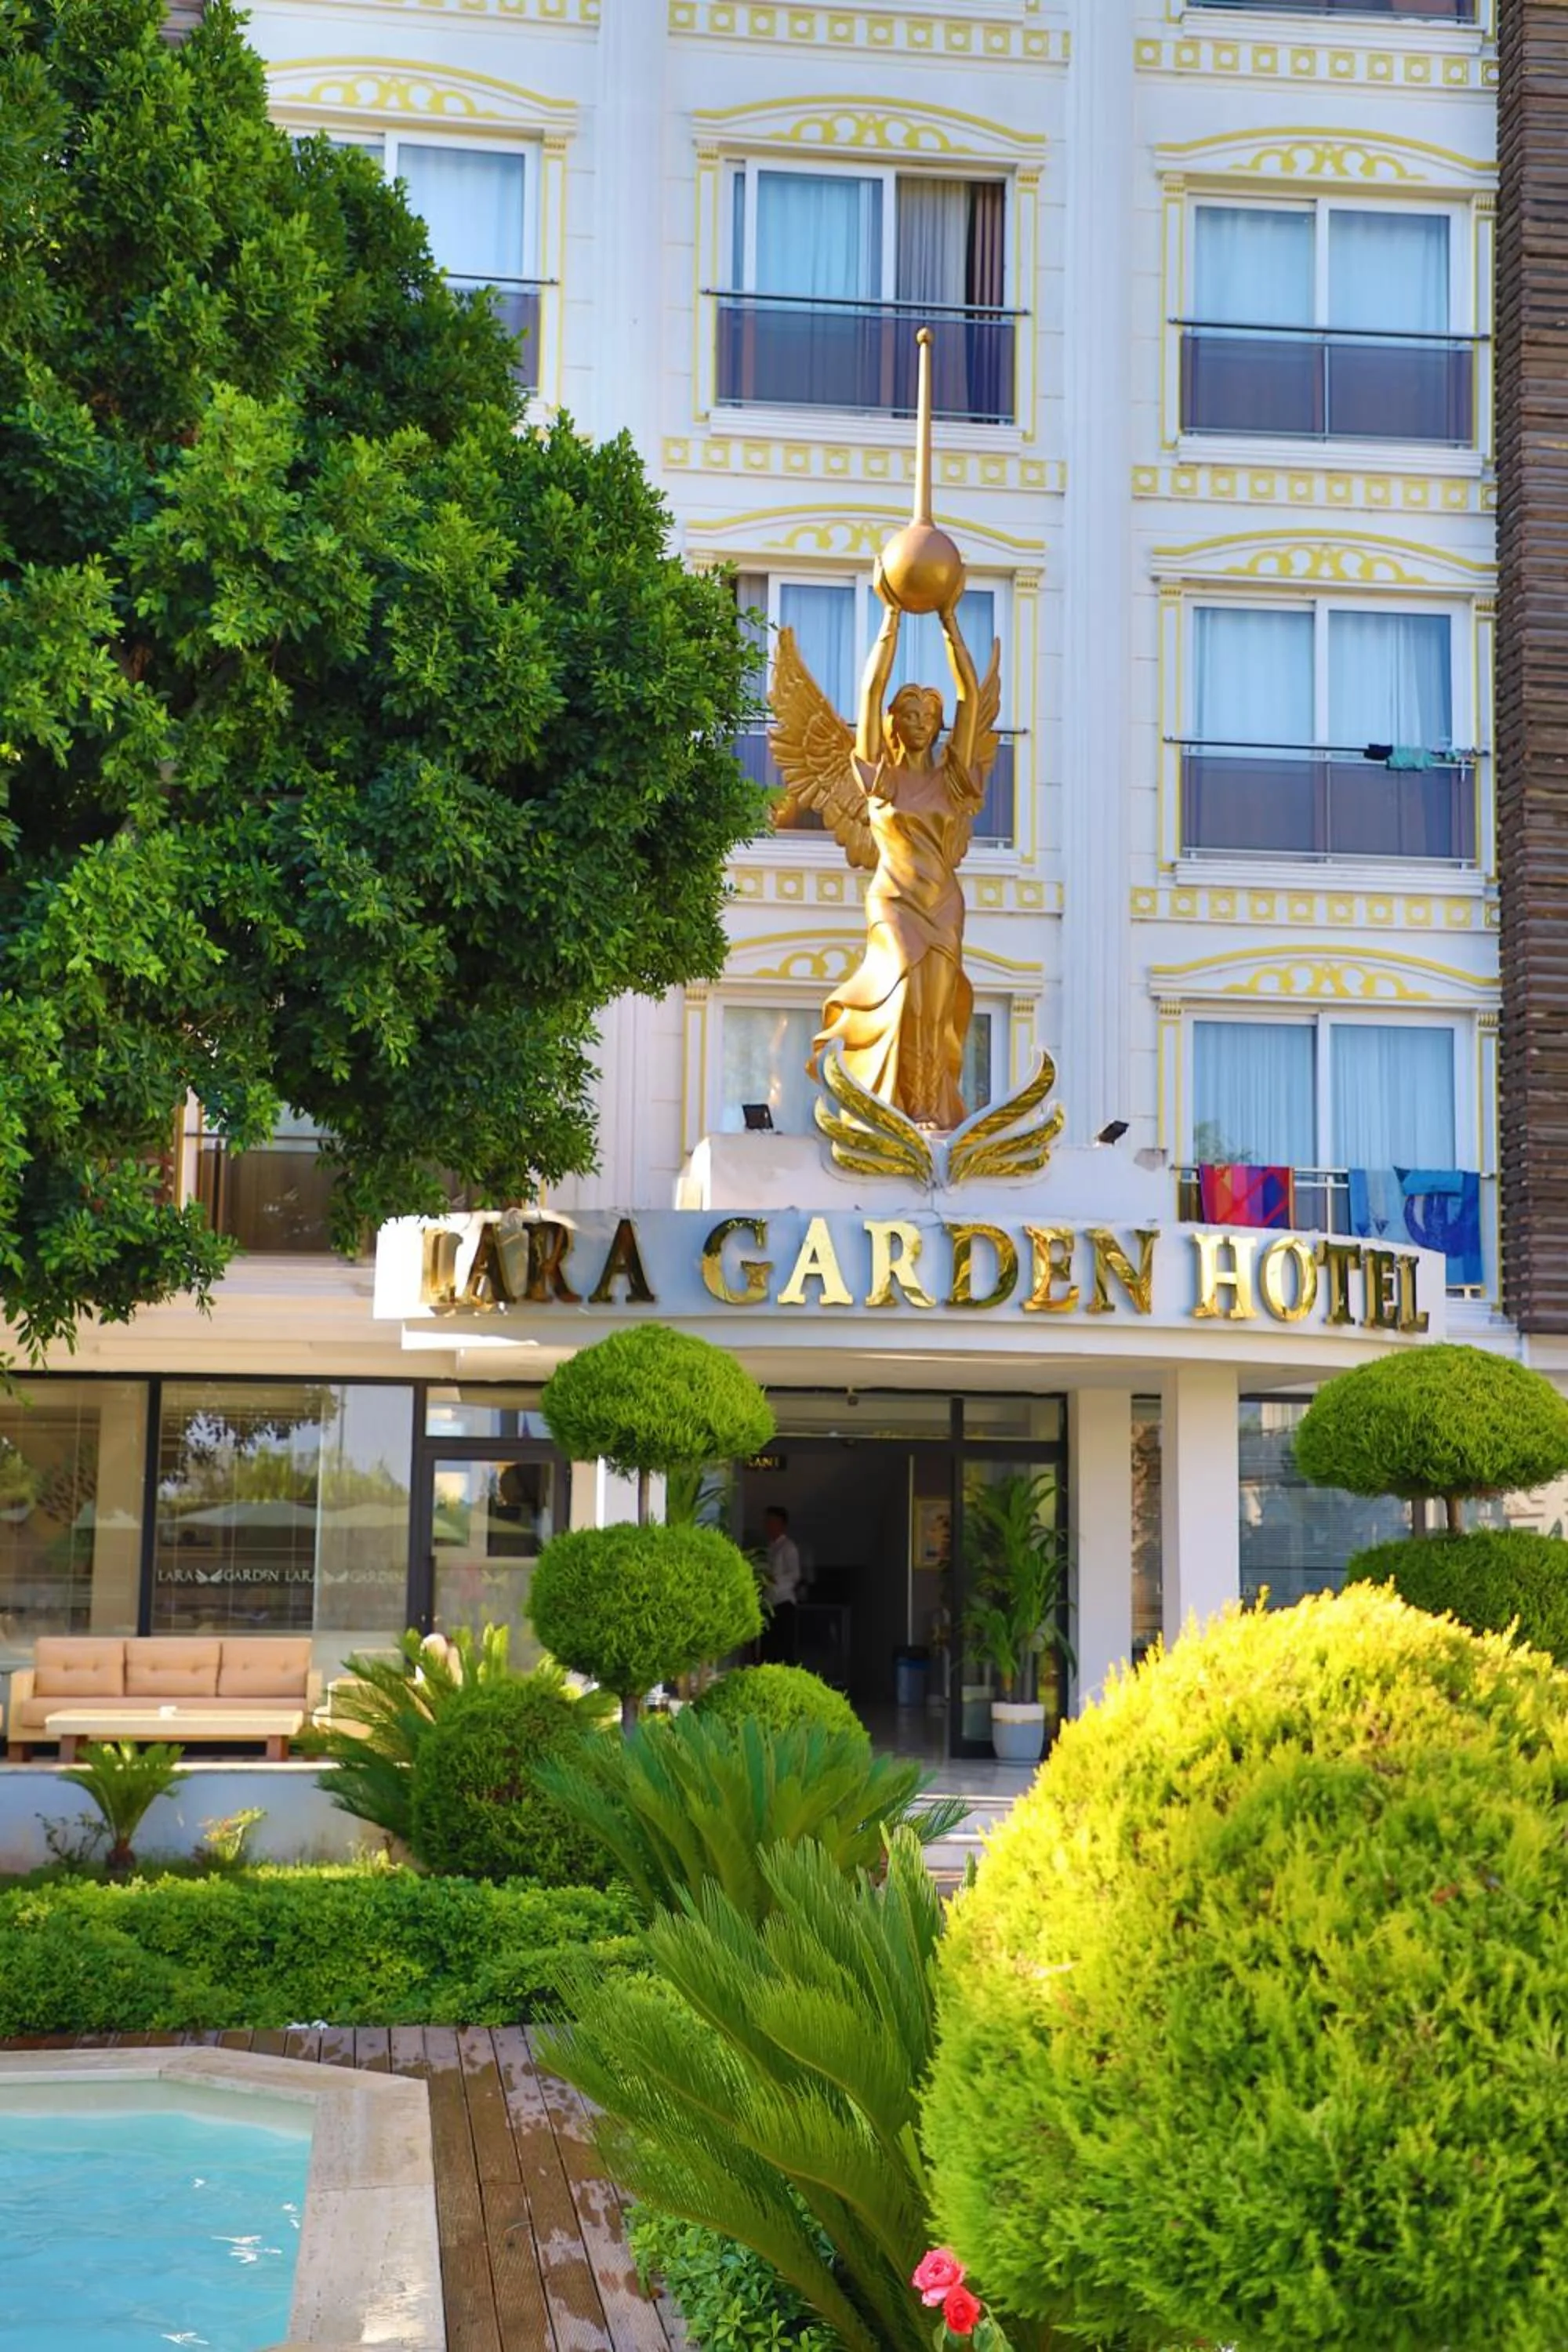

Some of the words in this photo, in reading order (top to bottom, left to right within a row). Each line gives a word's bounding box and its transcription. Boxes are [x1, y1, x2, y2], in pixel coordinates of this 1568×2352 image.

[421, 1217, 656, 1308] LARA
[702, 1217, 1161, 1315] GARDEN
[1192, 1232, 1430, 1334] HOTEL
[158, 1570, 193, 1582] LARA
